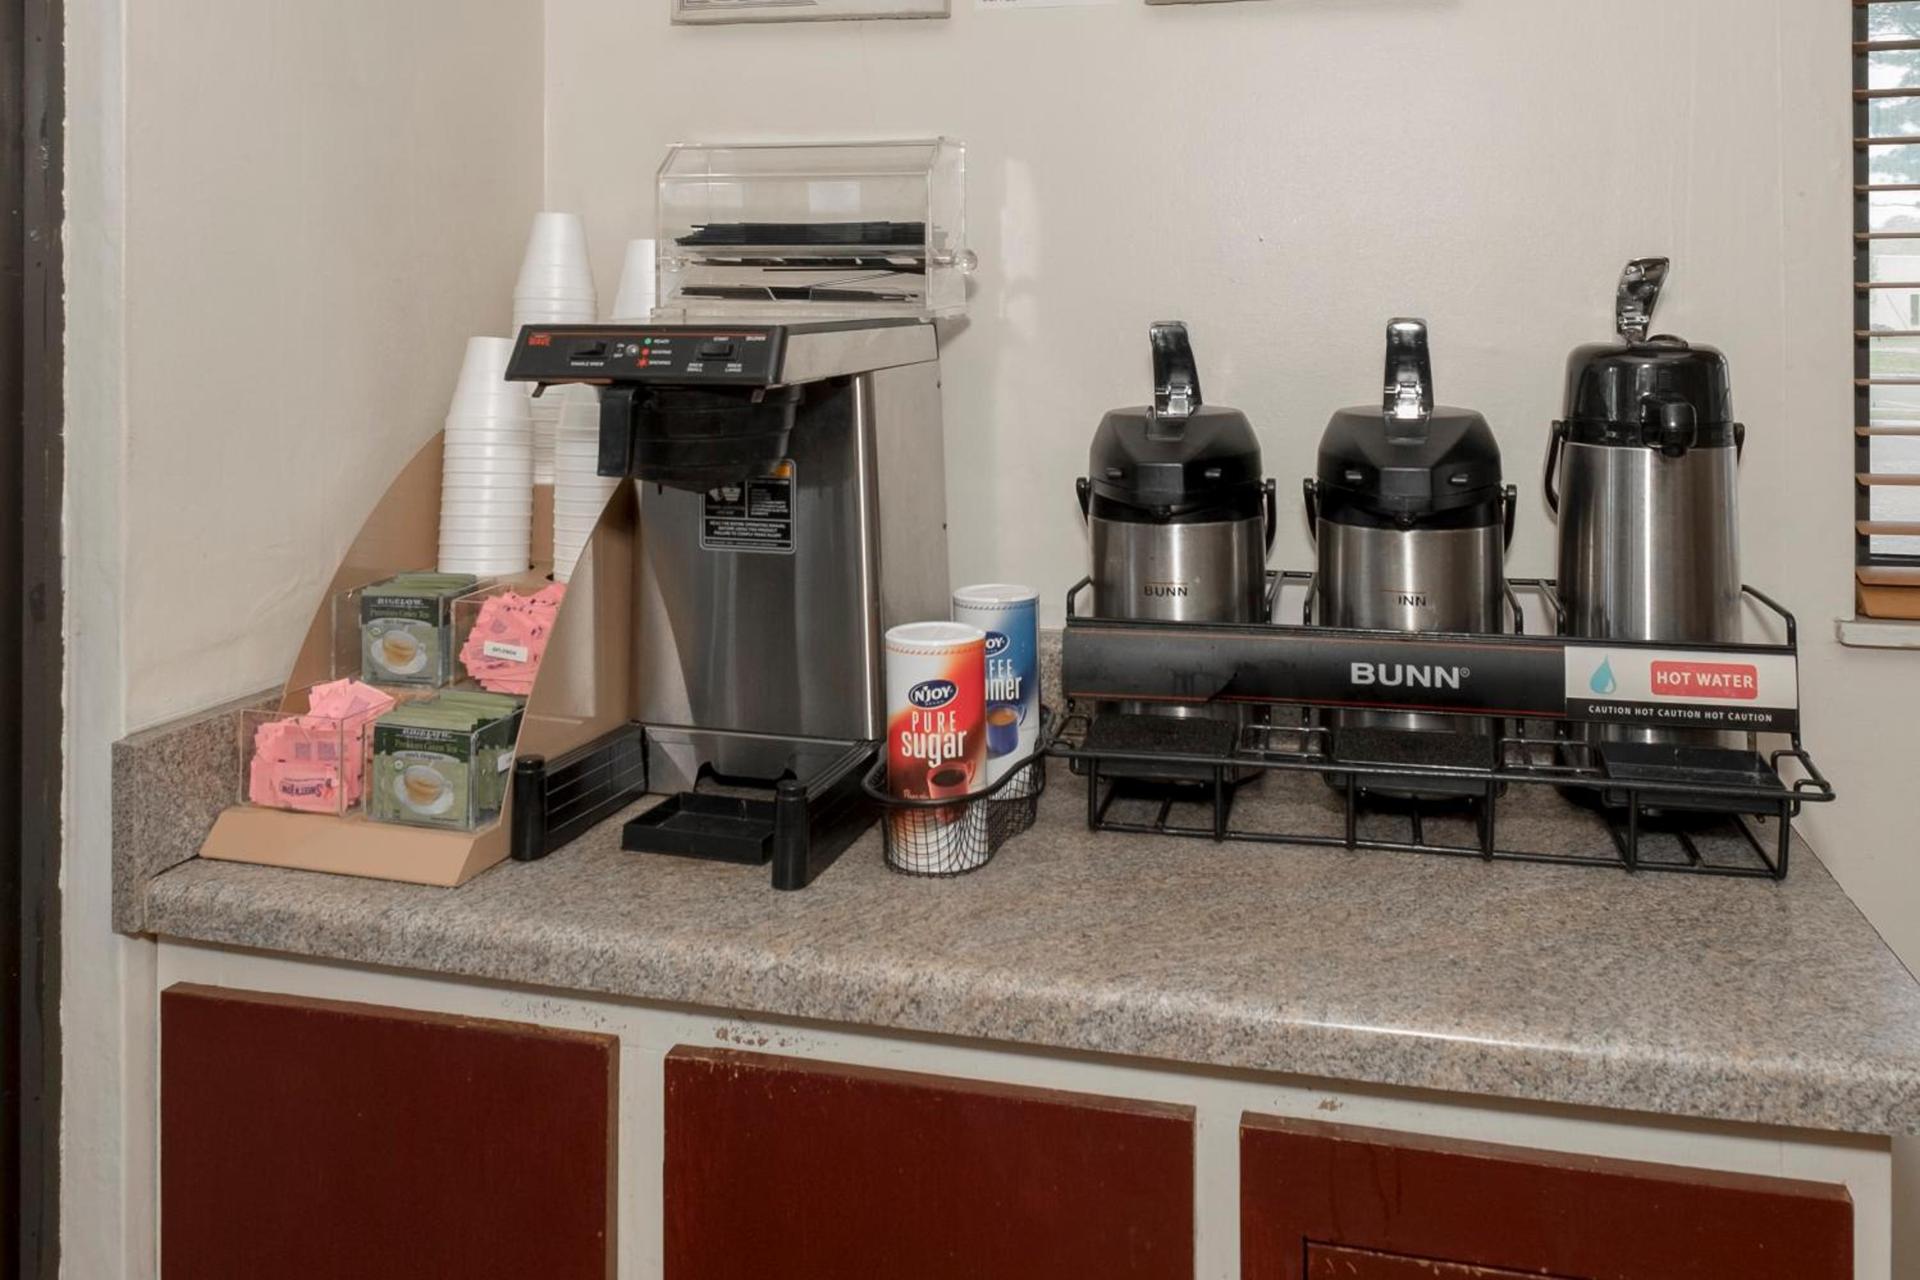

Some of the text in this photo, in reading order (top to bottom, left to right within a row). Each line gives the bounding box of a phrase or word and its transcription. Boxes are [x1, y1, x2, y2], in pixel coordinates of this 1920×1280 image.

[1144, 585, 1188, 597] BUNN
[985, 636, 1005, 650] OY
[989, 659, 1013, 678] FEE
[1656, 670, 1754, 689] HOT WATER
[912, 710, 957, 733] PURE
[1588, 704, 1773, 723] CAUTION HOT CAUTION HOT CAUTION
[901, 730, 968, 769] sugar
